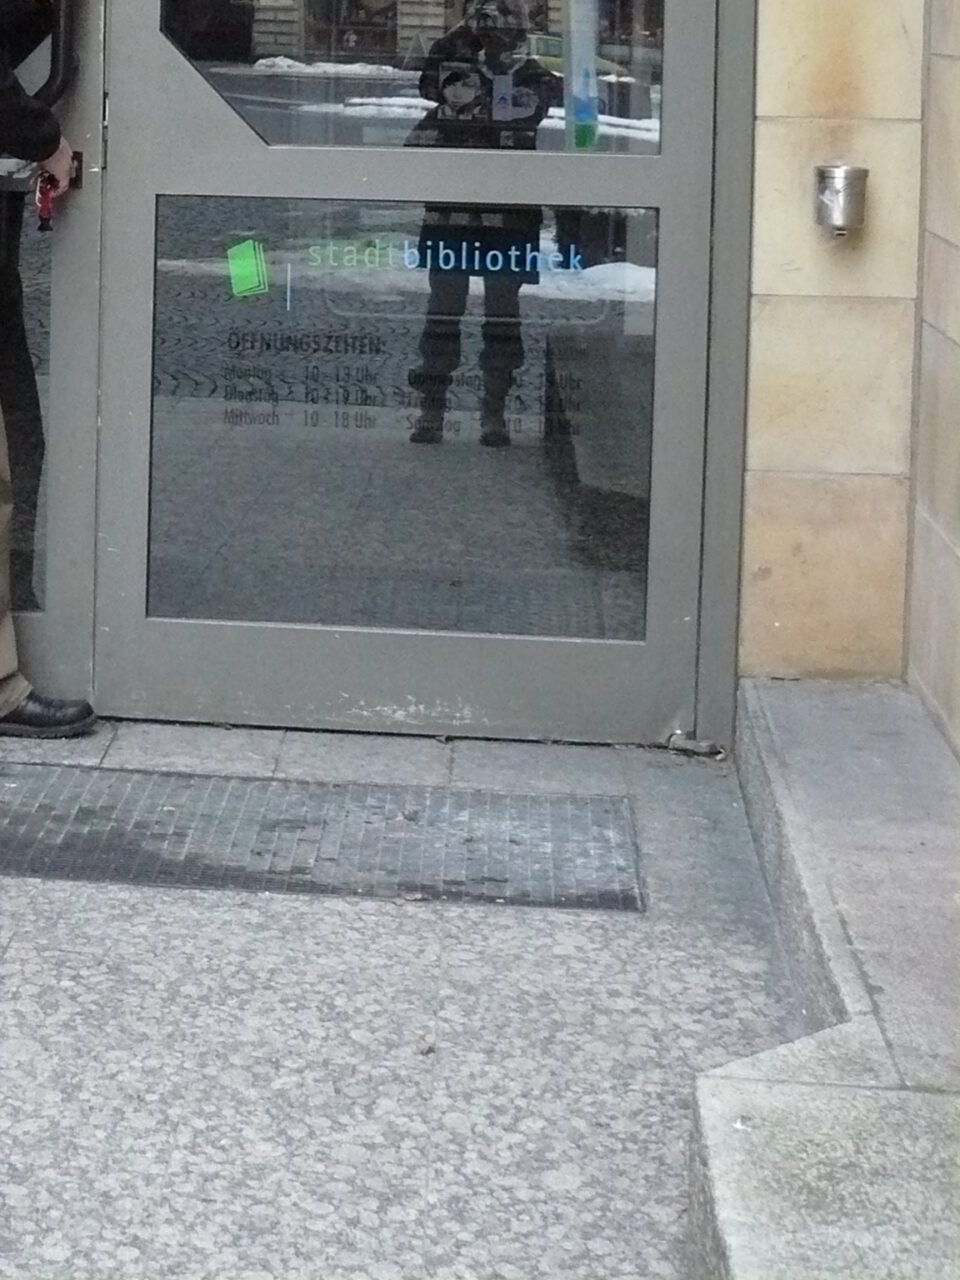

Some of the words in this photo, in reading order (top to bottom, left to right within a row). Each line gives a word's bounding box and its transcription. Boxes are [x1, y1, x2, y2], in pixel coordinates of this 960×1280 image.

[308, 239, 583, 271] stadtbibliothek
[224, 407, 280, 426] Mittwoch
[304, 410, 319, 428] 10
[334, 411, 350, 429] 18
[355, 411, 378, 429] Uhr
